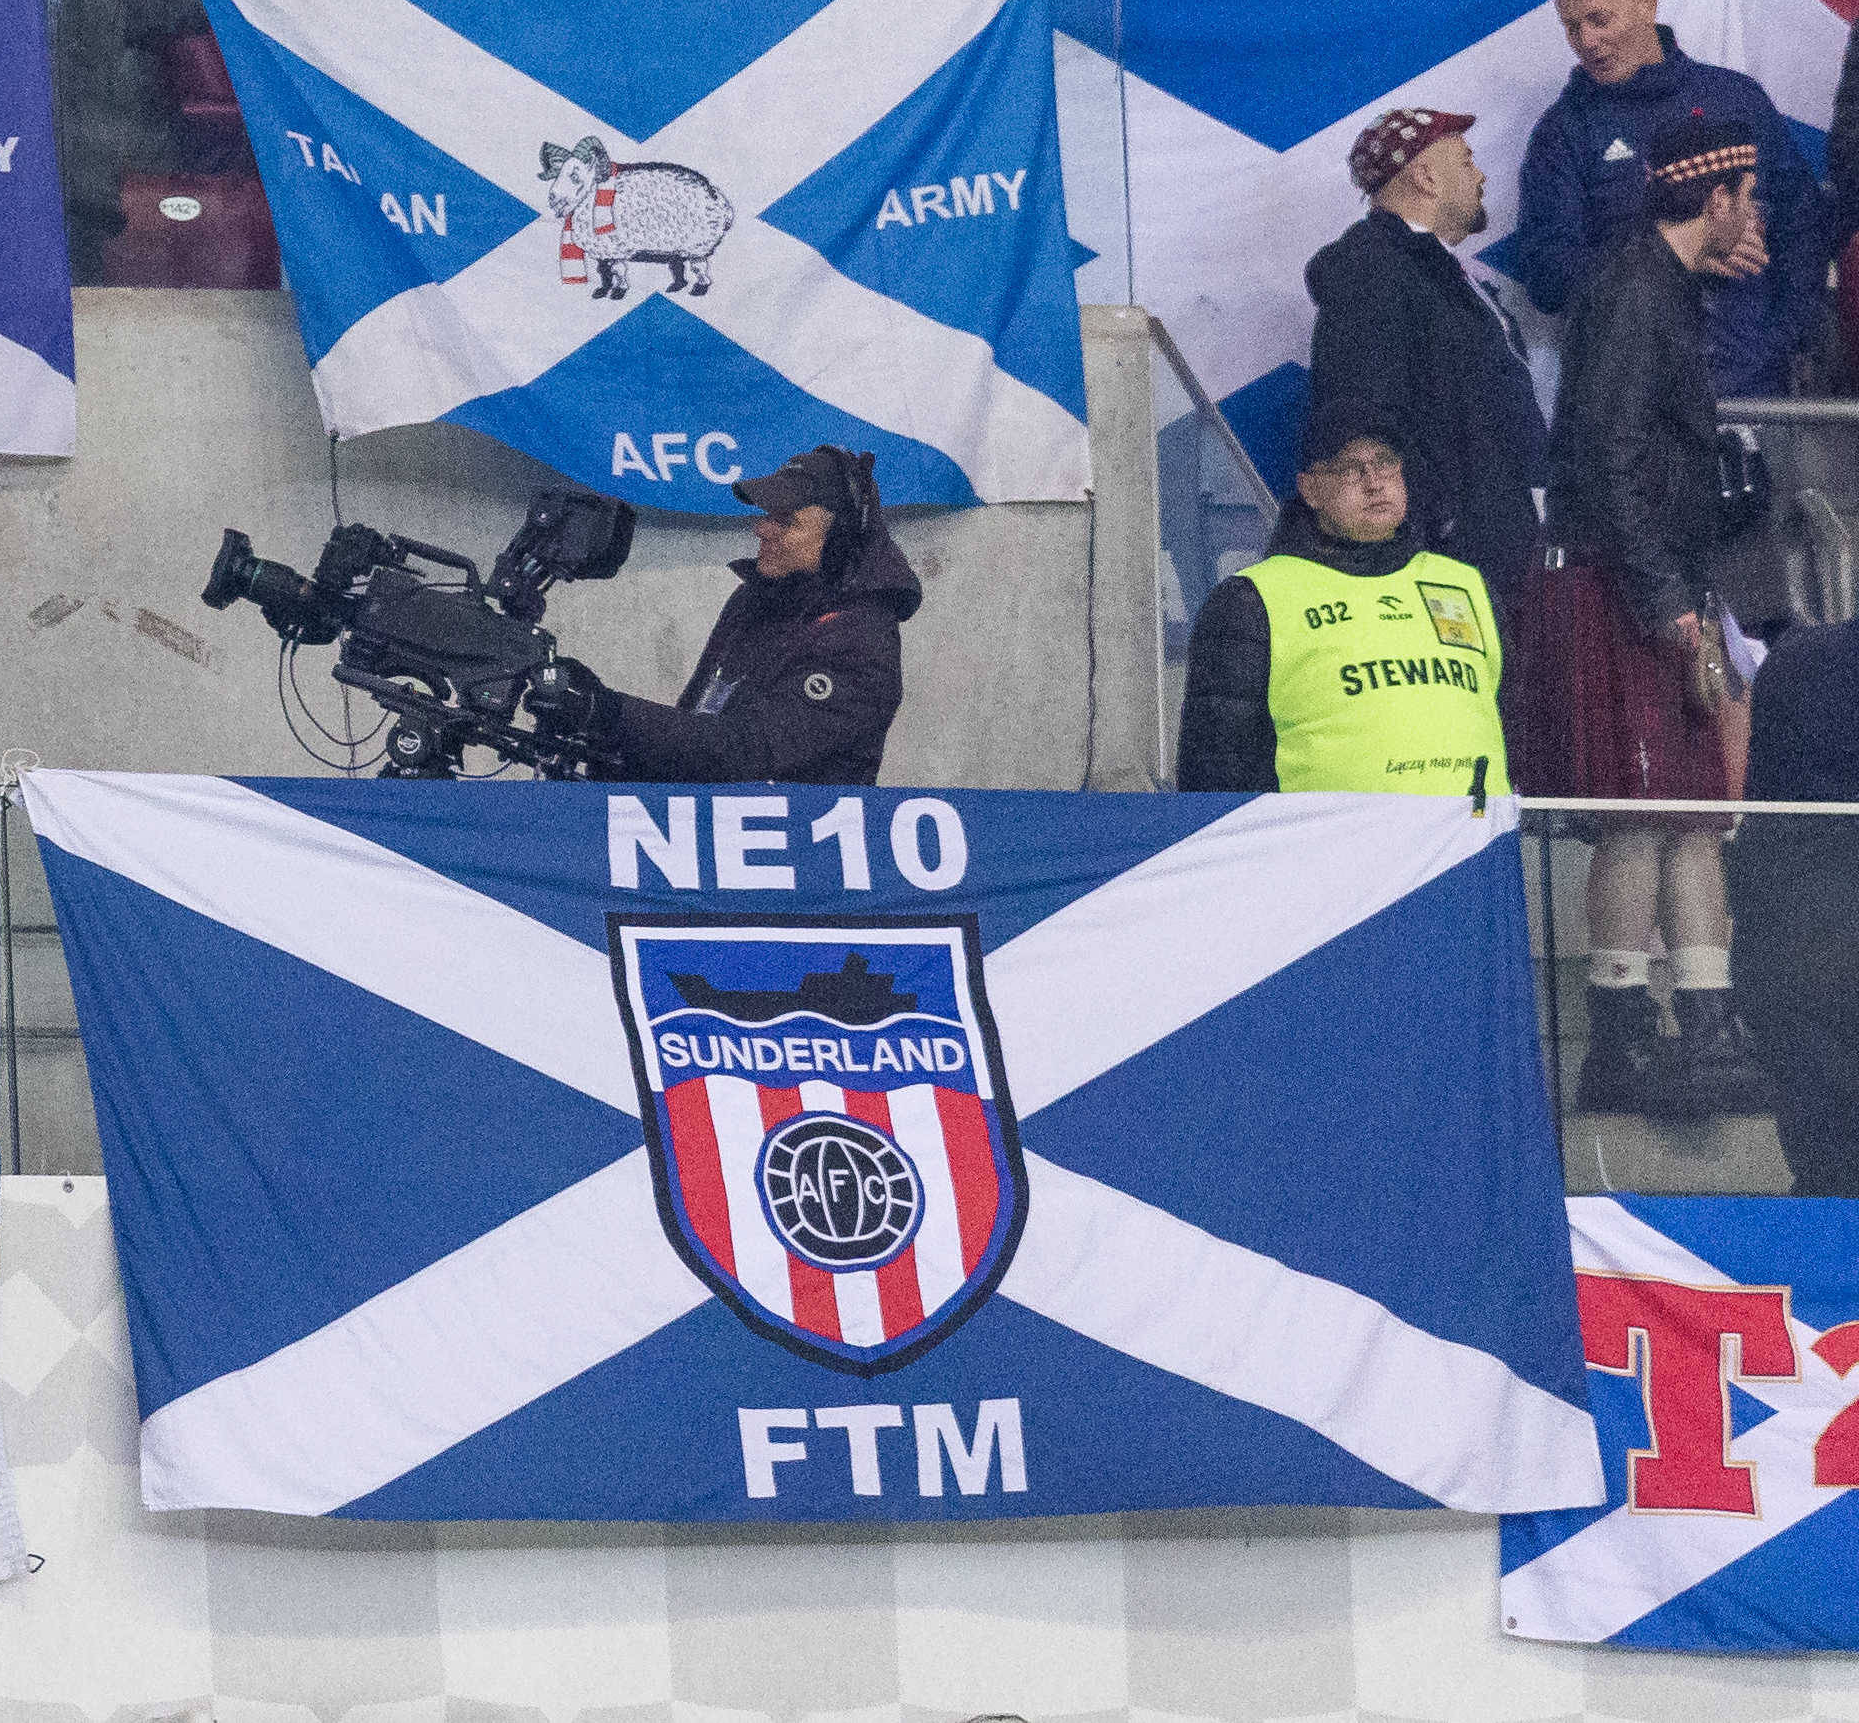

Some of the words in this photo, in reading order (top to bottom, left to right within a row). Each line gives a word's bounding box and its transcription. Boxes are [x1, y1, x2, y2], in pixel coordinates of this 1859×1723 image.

[287, 130, 447, 236] TAAN
[877, 170, 1027, 231] ARMY
[611, 431, 741, 483] AFC
[1340, 657, 1478, 696] STEWARD
[607, 794, 968, 891] NE10
[661, 1032, 965, 1074] SUNDERLAND
[1574, 1266, 1859, 1520] T
[737, 1398, 1029, 1499] FTM
